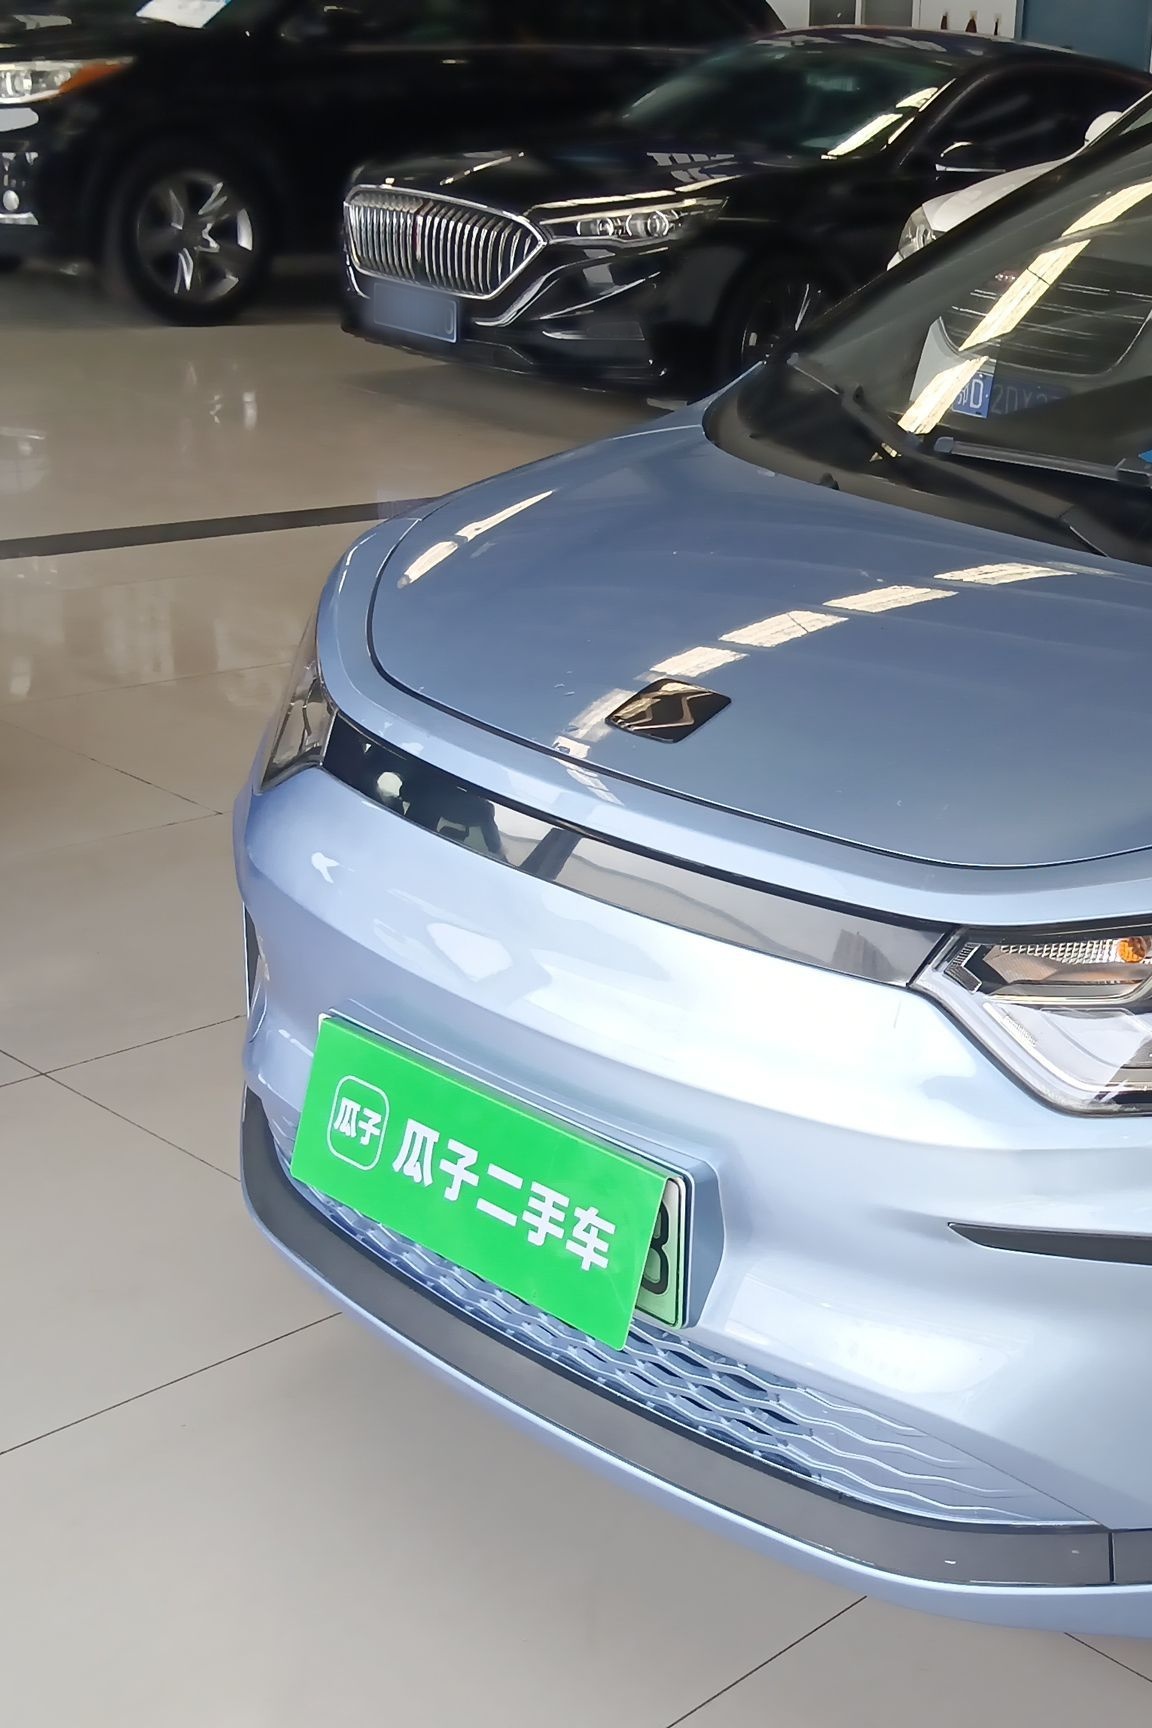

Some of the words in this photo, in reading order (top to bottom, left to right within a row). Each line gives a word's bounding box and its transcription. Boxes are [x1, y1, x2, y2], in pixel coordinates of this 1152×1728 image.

[333, 1097, 382, 1146] 瓜子
[392, 1118, 616, 1271] 瓜子二手车
